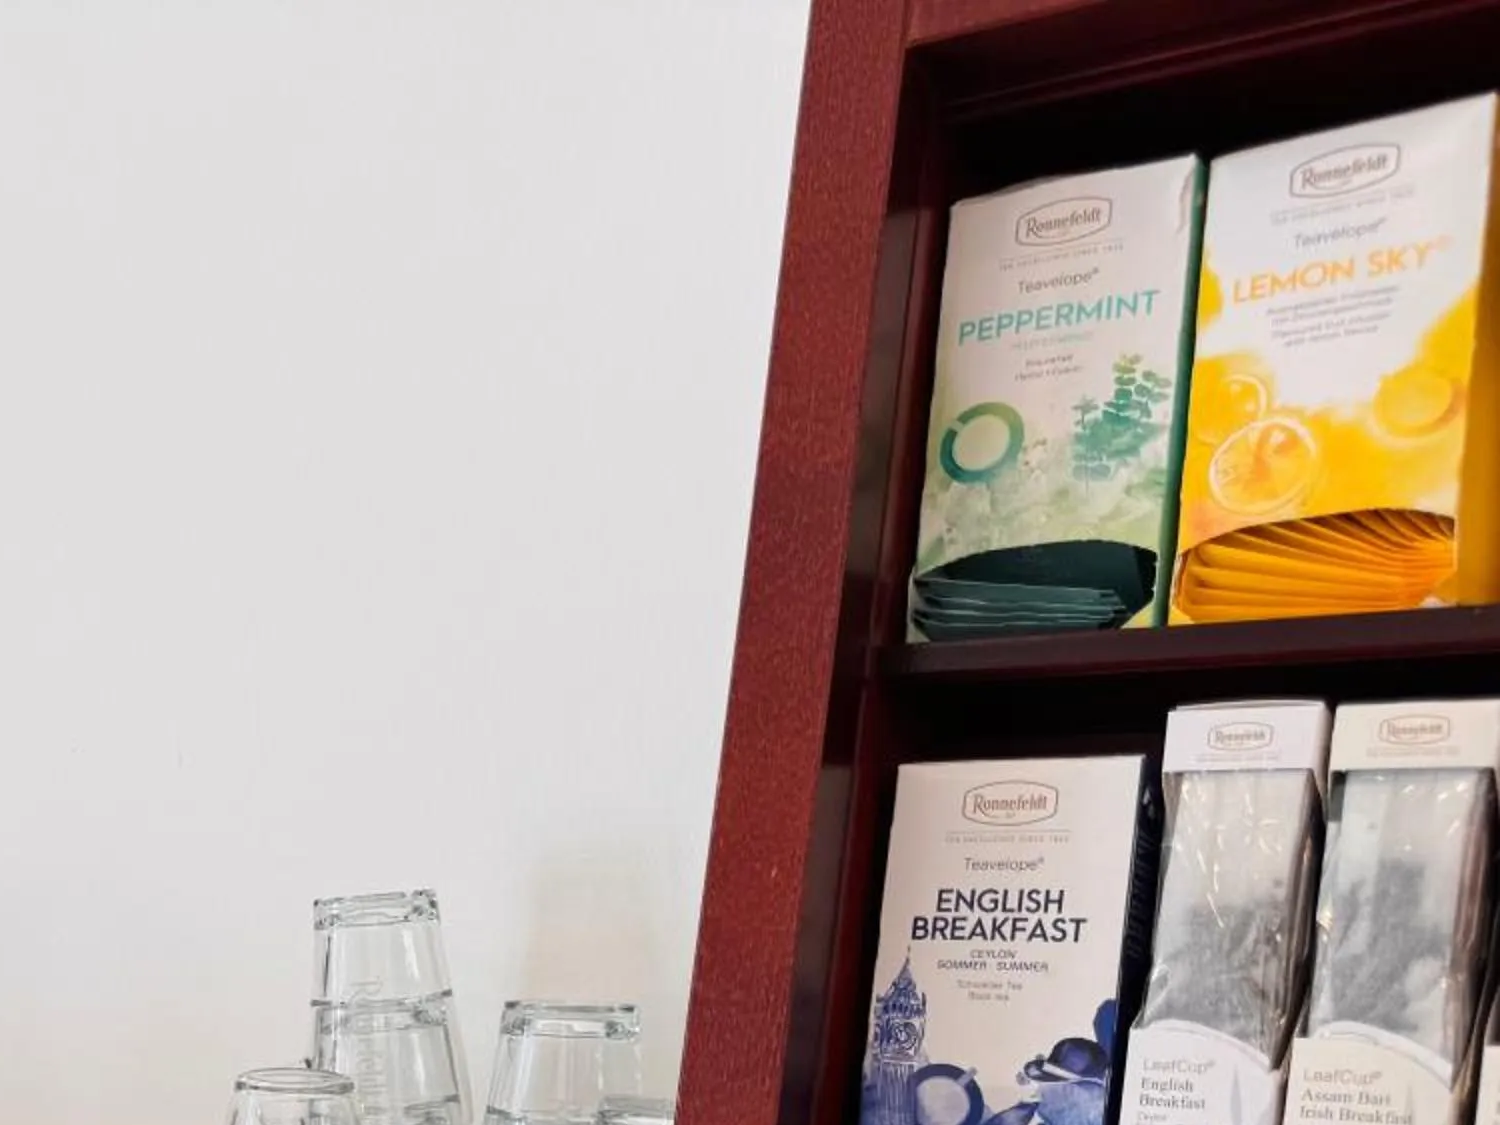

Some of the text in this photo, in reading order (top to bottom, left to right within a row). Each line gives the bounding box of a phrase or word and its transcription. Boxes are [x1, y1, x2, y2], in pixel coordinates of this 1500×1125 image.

[1025, 206, 1102, 238] Ronnefeldt
[1233, 259, 1356, 304] LEMON
[958, 290, 1160, 346] PEPPERMINT
[973, 794, 1048, 819] Ronnefeldt
[936, 888, 1065, 914] ENGLISH
[911, 916, 1087, 943] BREAKFAST
[970, 949, 1017, 960] CEYLON
[1141, 1077, 1195, 1096] English
[1301, 1088, 1354, 1104] Assam
[1139, 1094, 1206, 1111] Breakfast
